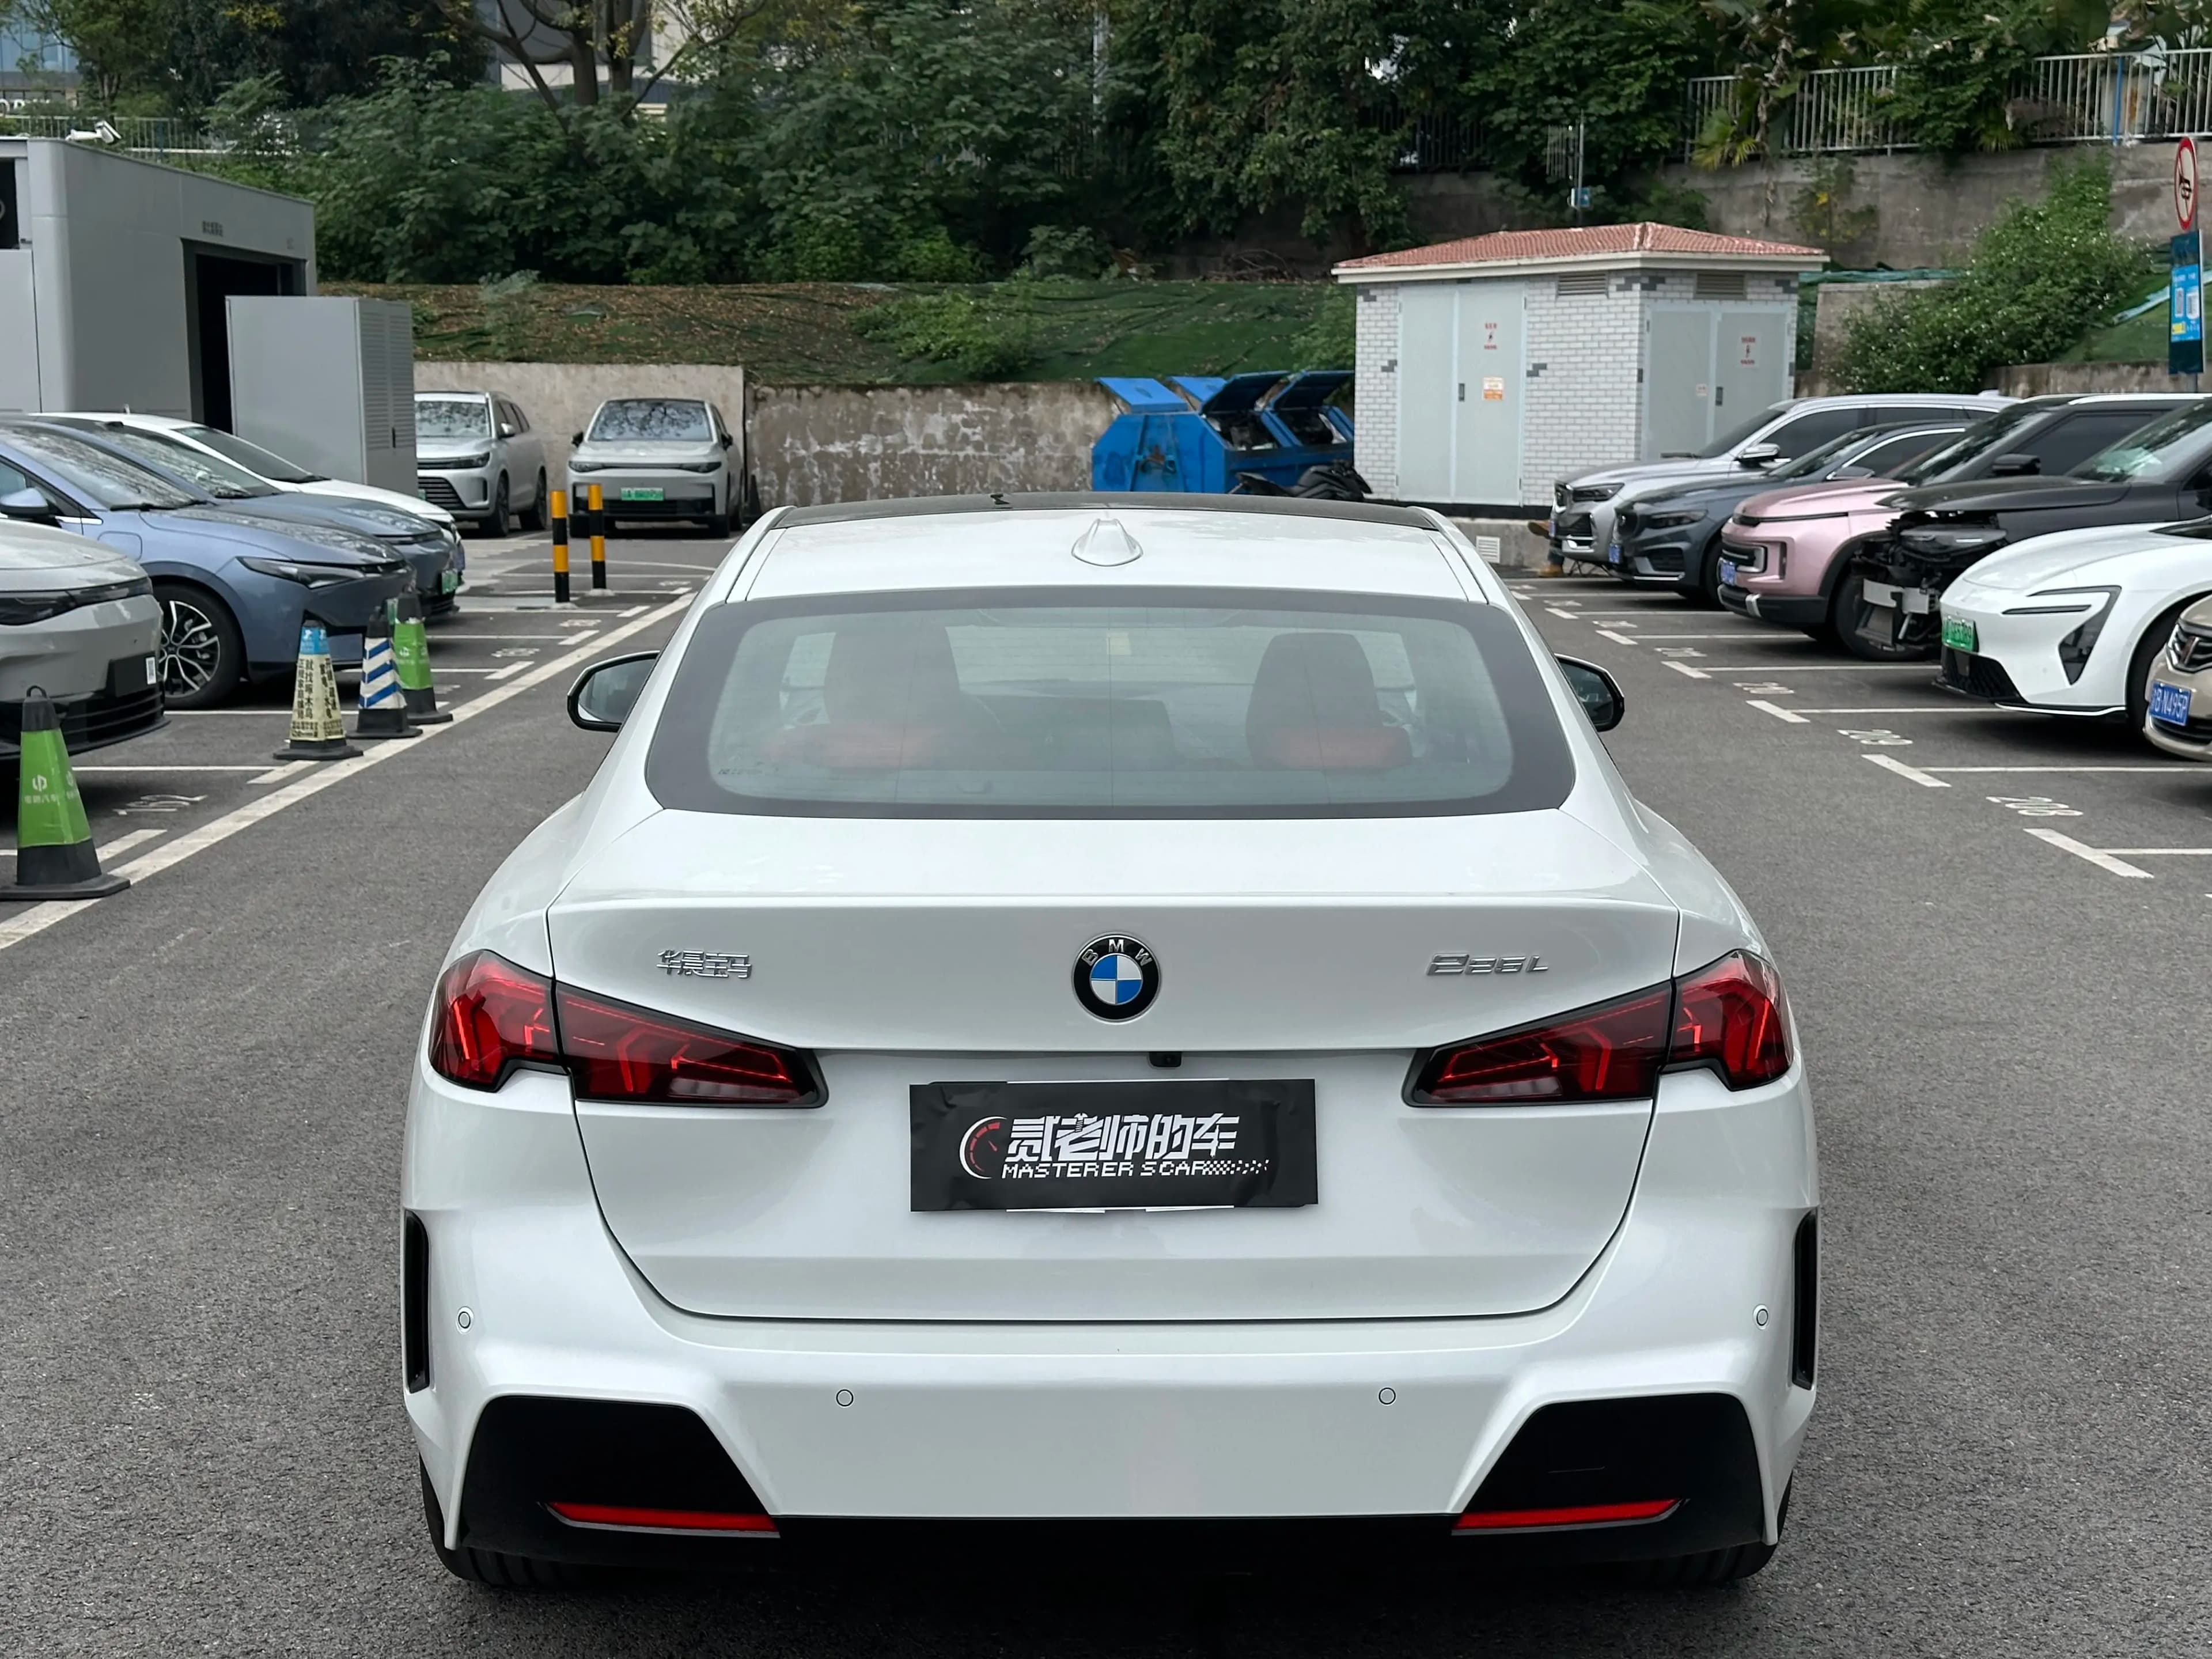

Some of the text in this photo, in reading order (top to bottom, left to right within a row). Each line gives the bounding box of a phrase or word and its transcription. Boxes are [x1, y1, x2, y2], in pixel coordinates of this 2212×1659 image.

[1985, 796, 2084, 816] 208
[656, 949, 752, 979] 华晨宝马
[1081, 938, 1153, 967] BMW
[1004, 1112, 1240, 1162] 贰老师的车
[1001, 1161, 1134, 1179] MASTERER
